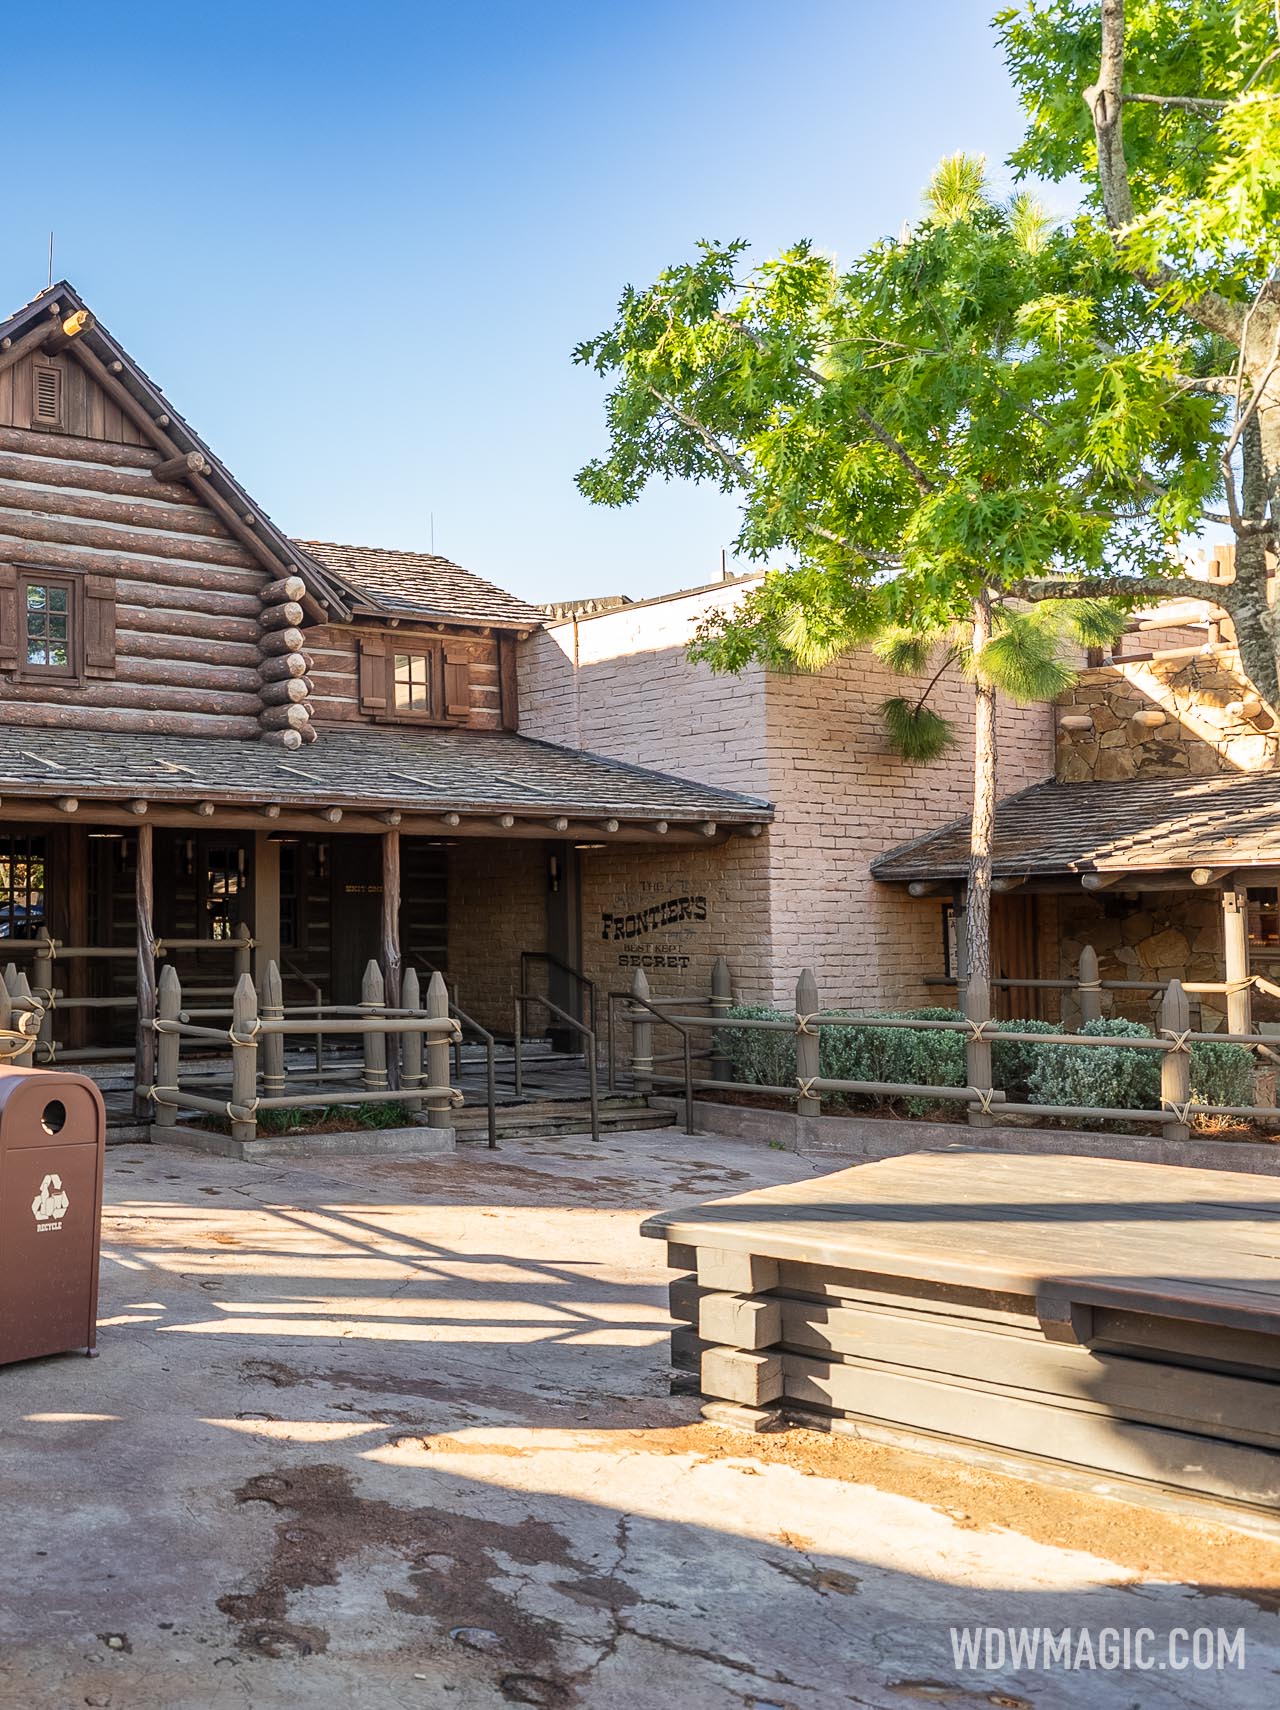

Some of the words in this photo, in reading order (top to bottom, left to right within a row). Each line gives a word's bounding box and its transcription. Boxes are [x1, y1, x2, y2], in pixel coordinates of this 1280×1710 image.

[640, 880, 664, 892] THE
[624, 944, 652, 953] BEST
[655, 944, 683, 953] KEPT
[618, 955, 690, 968] SECRET
[37, 1221, 62, 1232] RECYCLE
